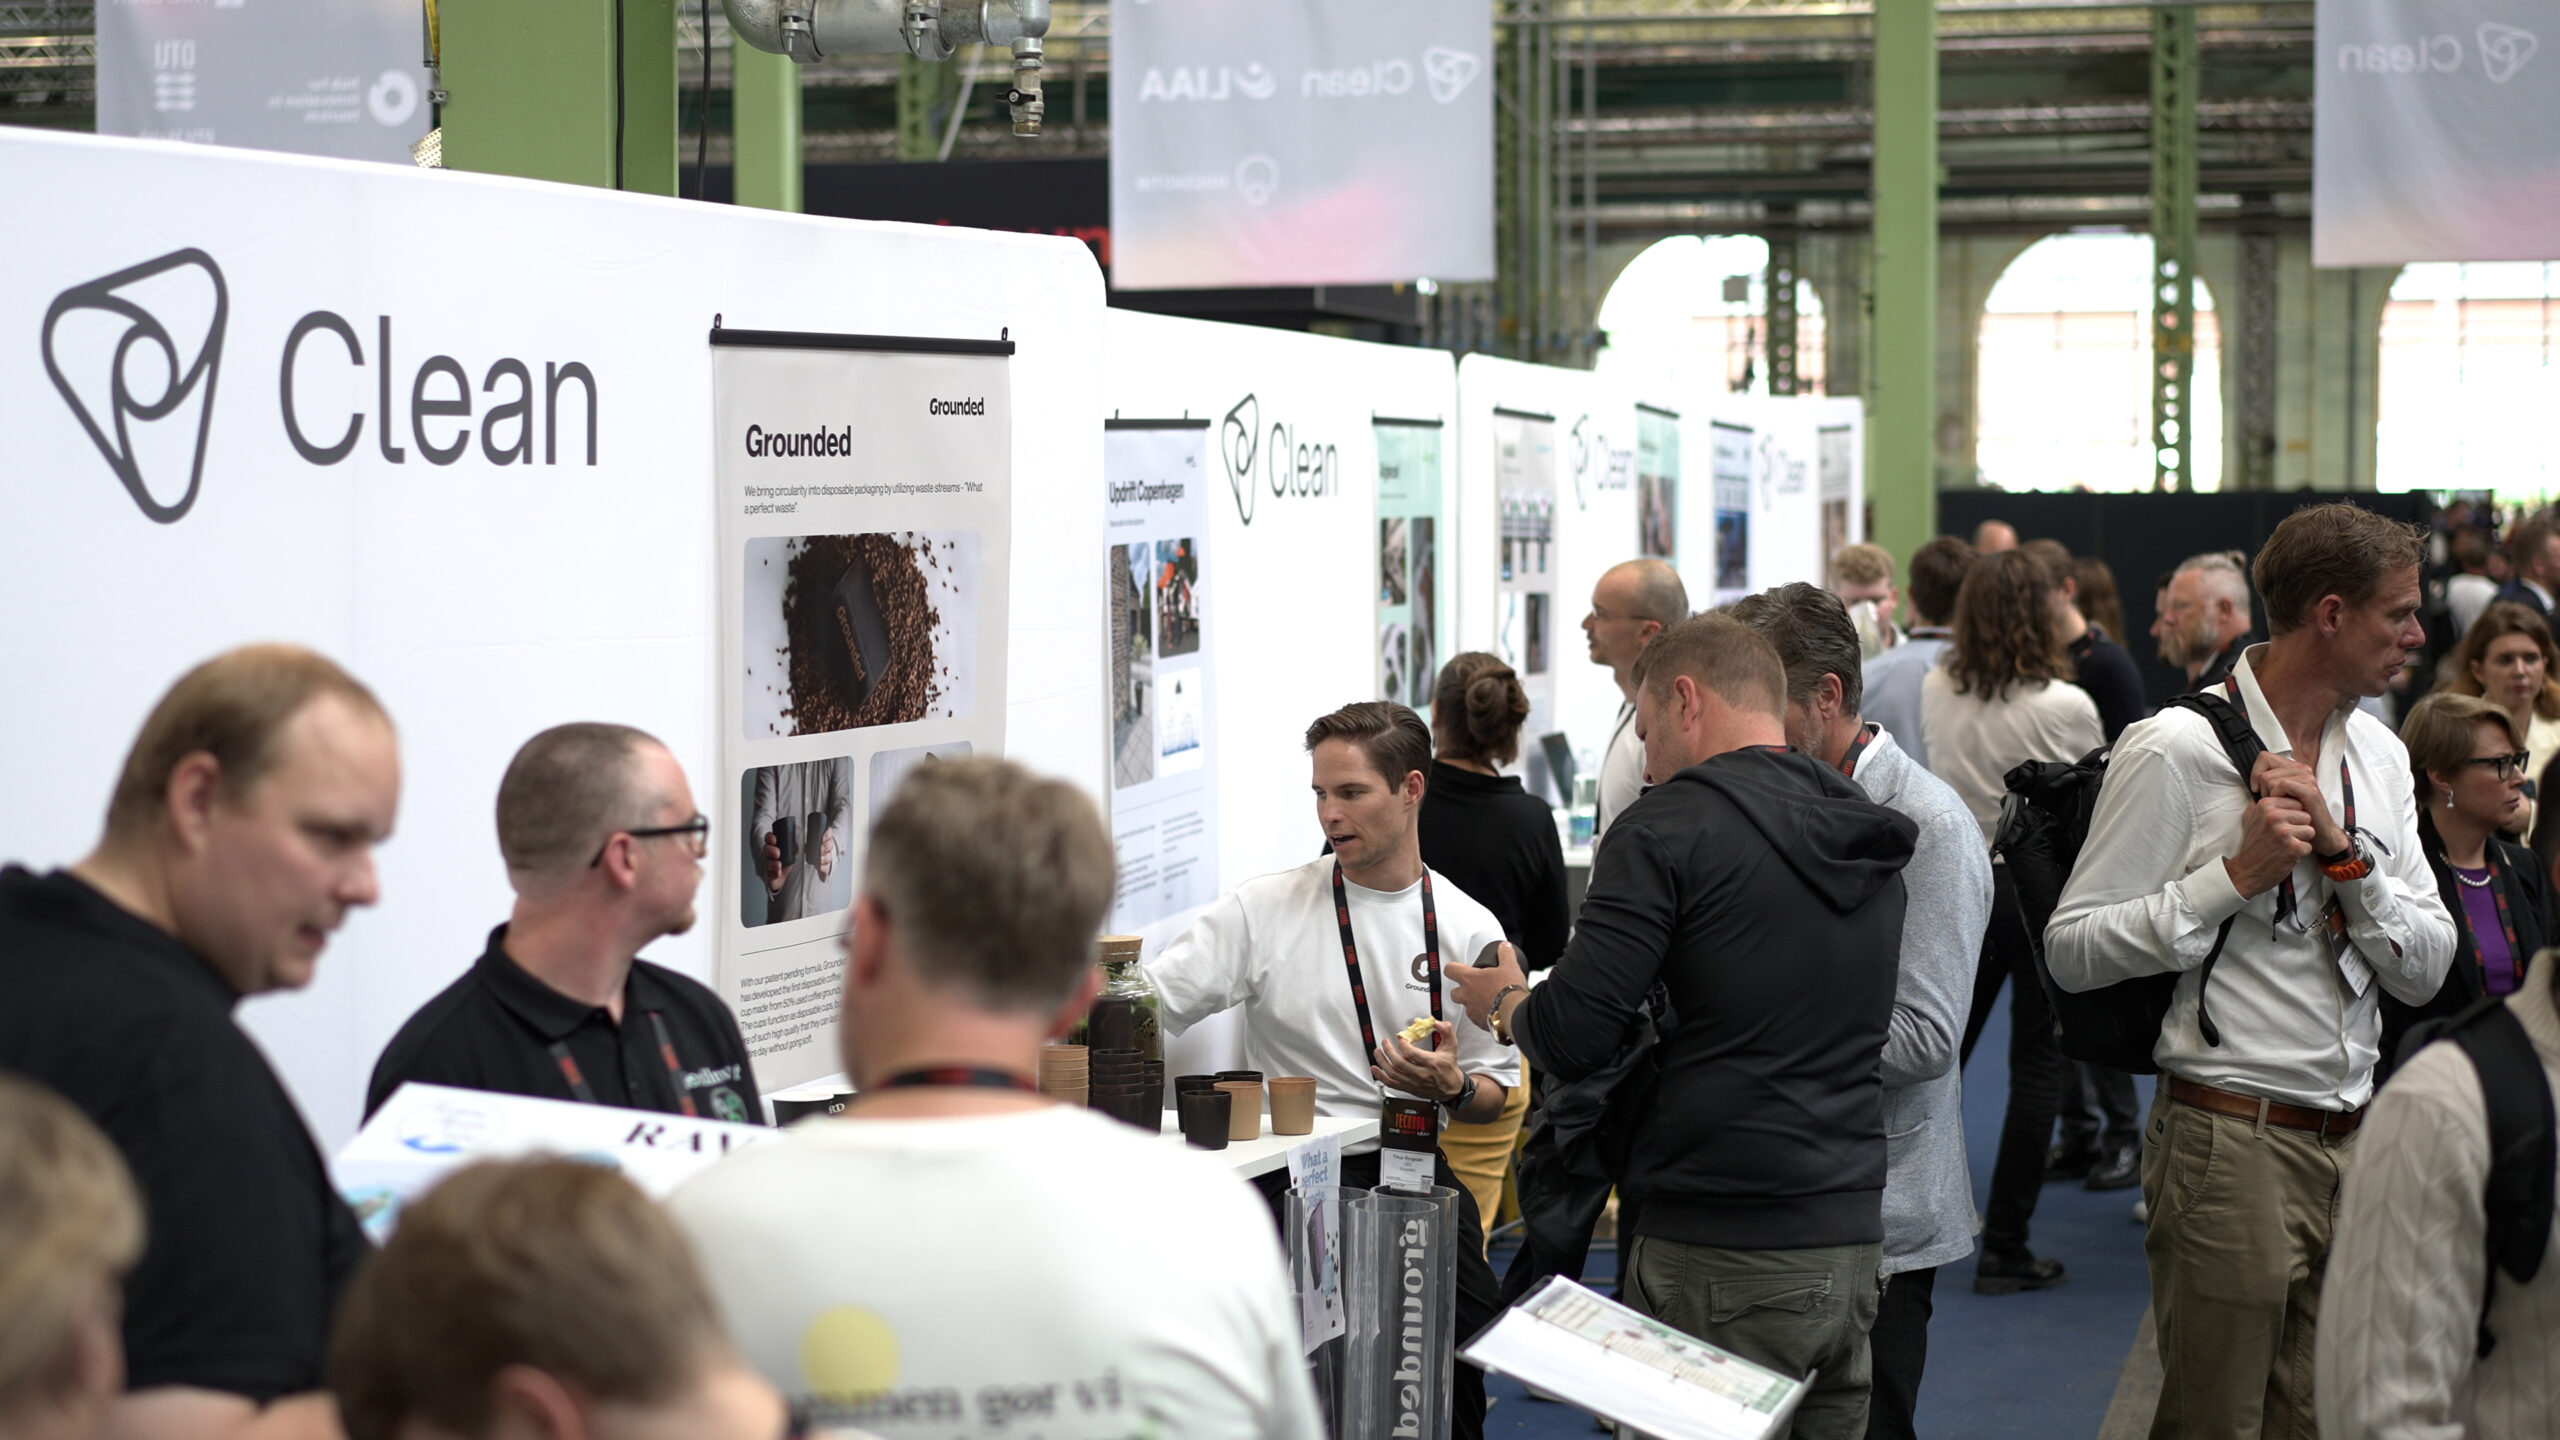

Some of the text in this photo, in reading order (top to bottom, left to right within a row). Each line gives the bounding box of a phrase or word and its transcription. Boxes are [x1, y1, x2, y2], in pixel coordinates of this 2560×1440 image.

[280, 310, 599, 466] Clean
[929, 397, 985, 416] Grounded
[745, 424, 852, 457] Grounded
[1268, 422, 1339, 498] Clean
[744, 485, 756, 497] We
[757, 485, 774, 498] bring
[775, 484, 808, 498] circularity
[808, 484, 821, 496] into
[821, 483, 854, 497] disposable
[855, 482, 884, 496] packaging
[884, 482, 893, 496] by
[892, 482, 915, 496] utilizing
[915, 482, 934, 494] waste
[935, 482, 961, 493] streams
[1137, 479, 1185, 506] Copenhagen
[744, 504, 749, 515] a
[750, 502, 774, 516] perfect
[835, 604, 868, 682] Grounded
[740, 977, 754, 989] With
[754, 976, 764, 986] our
[765, 971, 784, 985] patent
[784, 967, 805, 981] pending
[740, 993, 751, 1003] has
[752, 986, 782, 1001] developed
[782, 984, 792, 995] the
[791, 982, 801, 992] first
[801, 976, 826, 990] disposable
[740, 1007, 753, 1018] cup
[752, 1003, 769, 1014] made
[769, 1000, 783, 1011] from
[783, 997, 796, 1009] 50%
[795, 993, 808, 1006] used
[807, 989, 822, 1003] coffee
[740, 1020, 753, 1031] The
[752, 1018, 768, 1030] cups
[767, 1011, 789, 1026] function
[789, 1012, 797, 1021] as
[796, 1004, 822, 1020] disposable
[751, 1033, 758, 1044] of
[757, 1029, 772, 1043] such
[771, 1026, 786, 1041] high
[785, 1023, 801, 1037] quality
[800, 1019, 810, 1032] that
[810, 1017, 821, 1031] they
[757, 1047, 768, 1059] day
[768, 1040, 789, 1054] without
[788, 1036, 802, 1050] going
[828, 1102, 846, 1115] RD
[1300, 1149, 1328, 1169] What a
[1301, 1165, 1328, 1188] perfect
